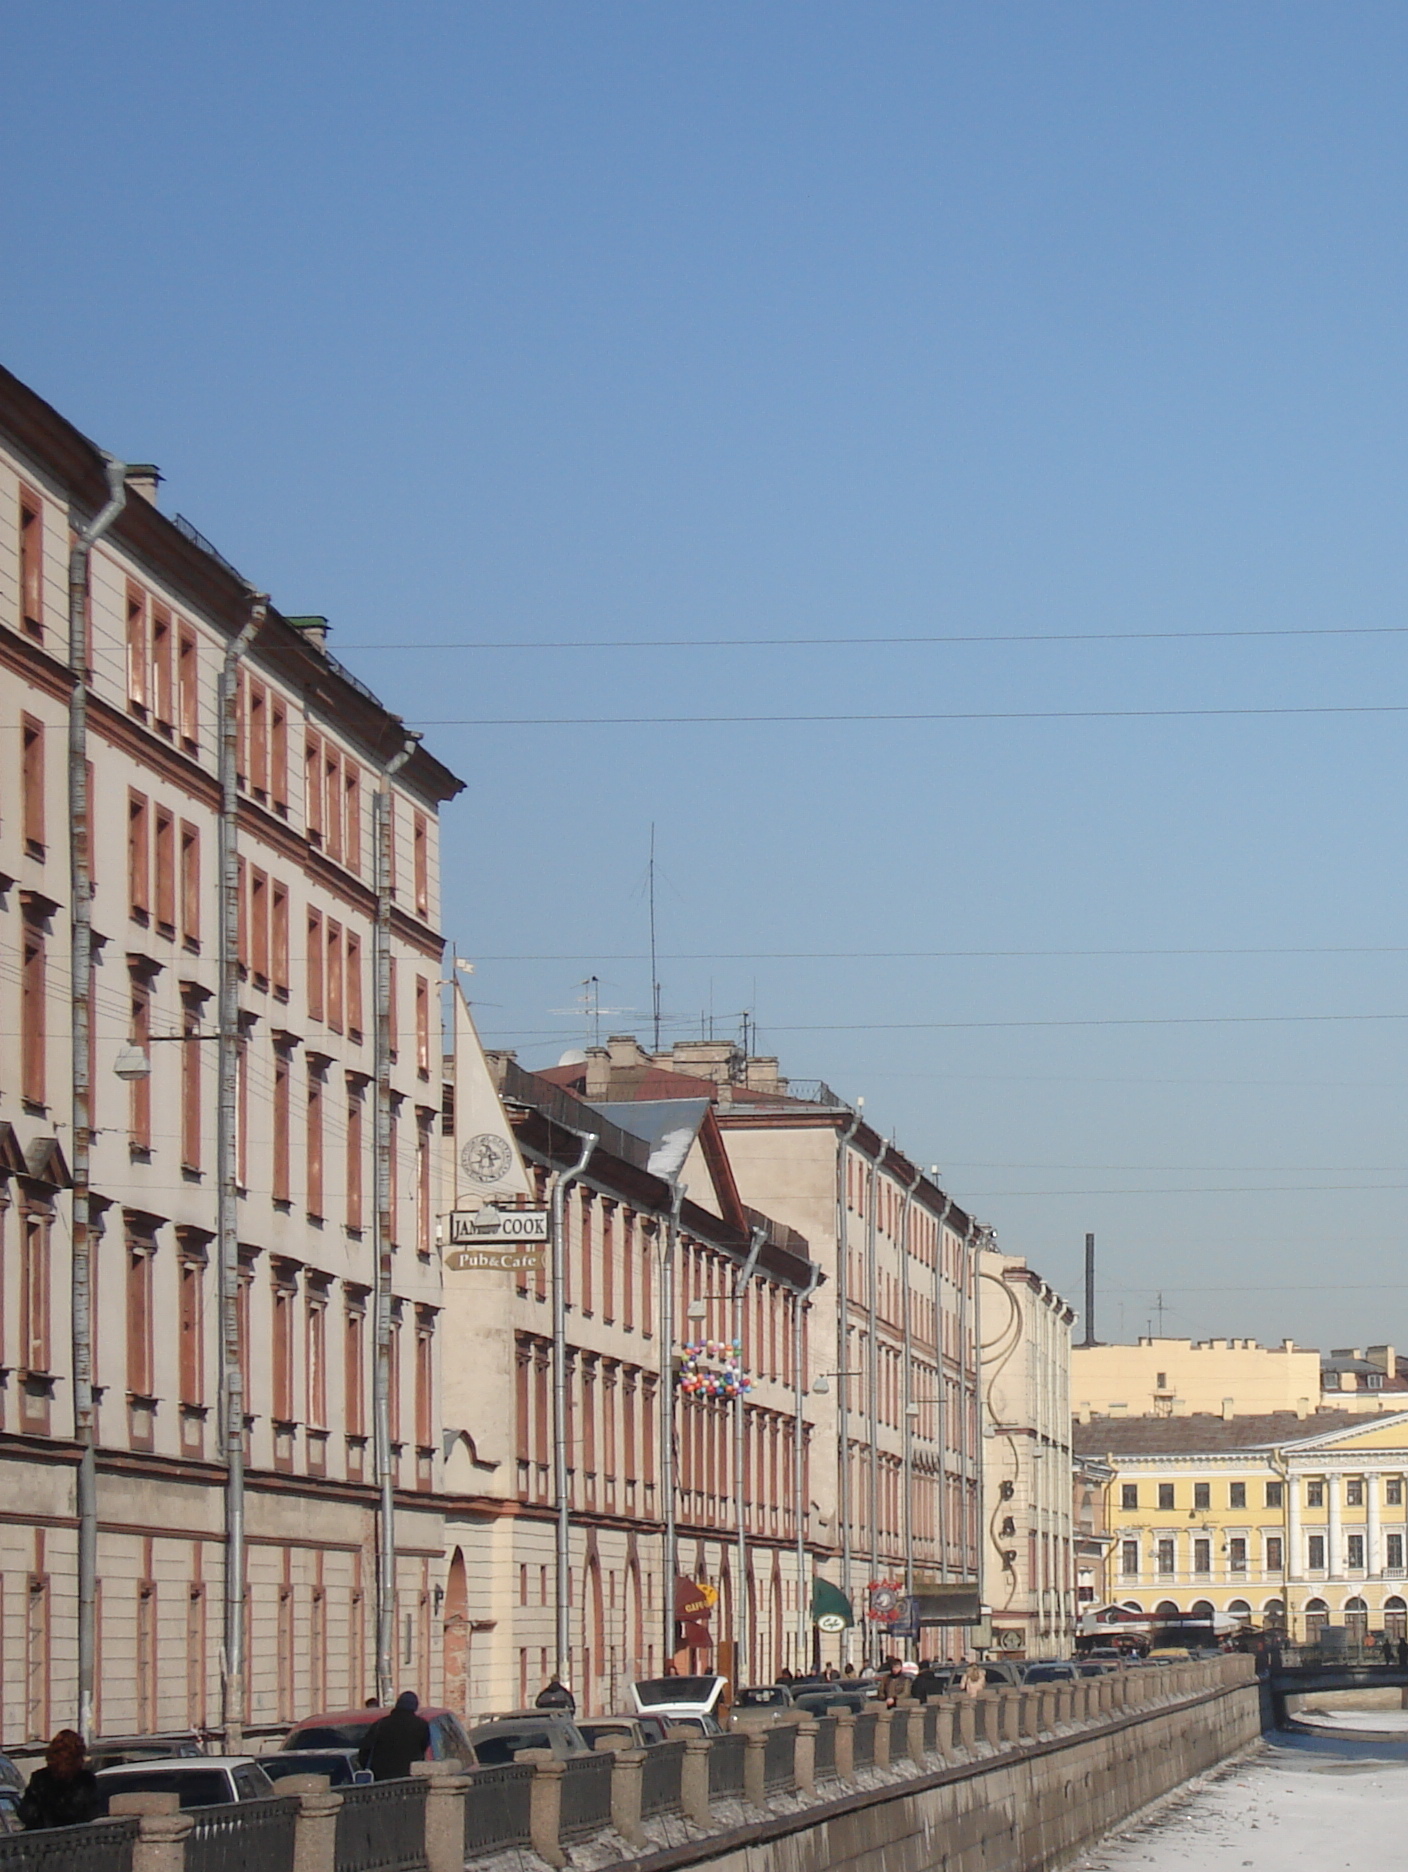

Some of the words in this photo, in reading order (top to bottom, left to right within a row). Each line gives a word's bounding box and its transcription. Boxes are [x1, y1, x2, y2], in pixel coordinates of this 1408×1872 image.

[453, 1219, 498, 1240] JAM
[503, 1218, 545, 1235] COOK
[460, 1253, 537, 1268] Pub&Cafe
